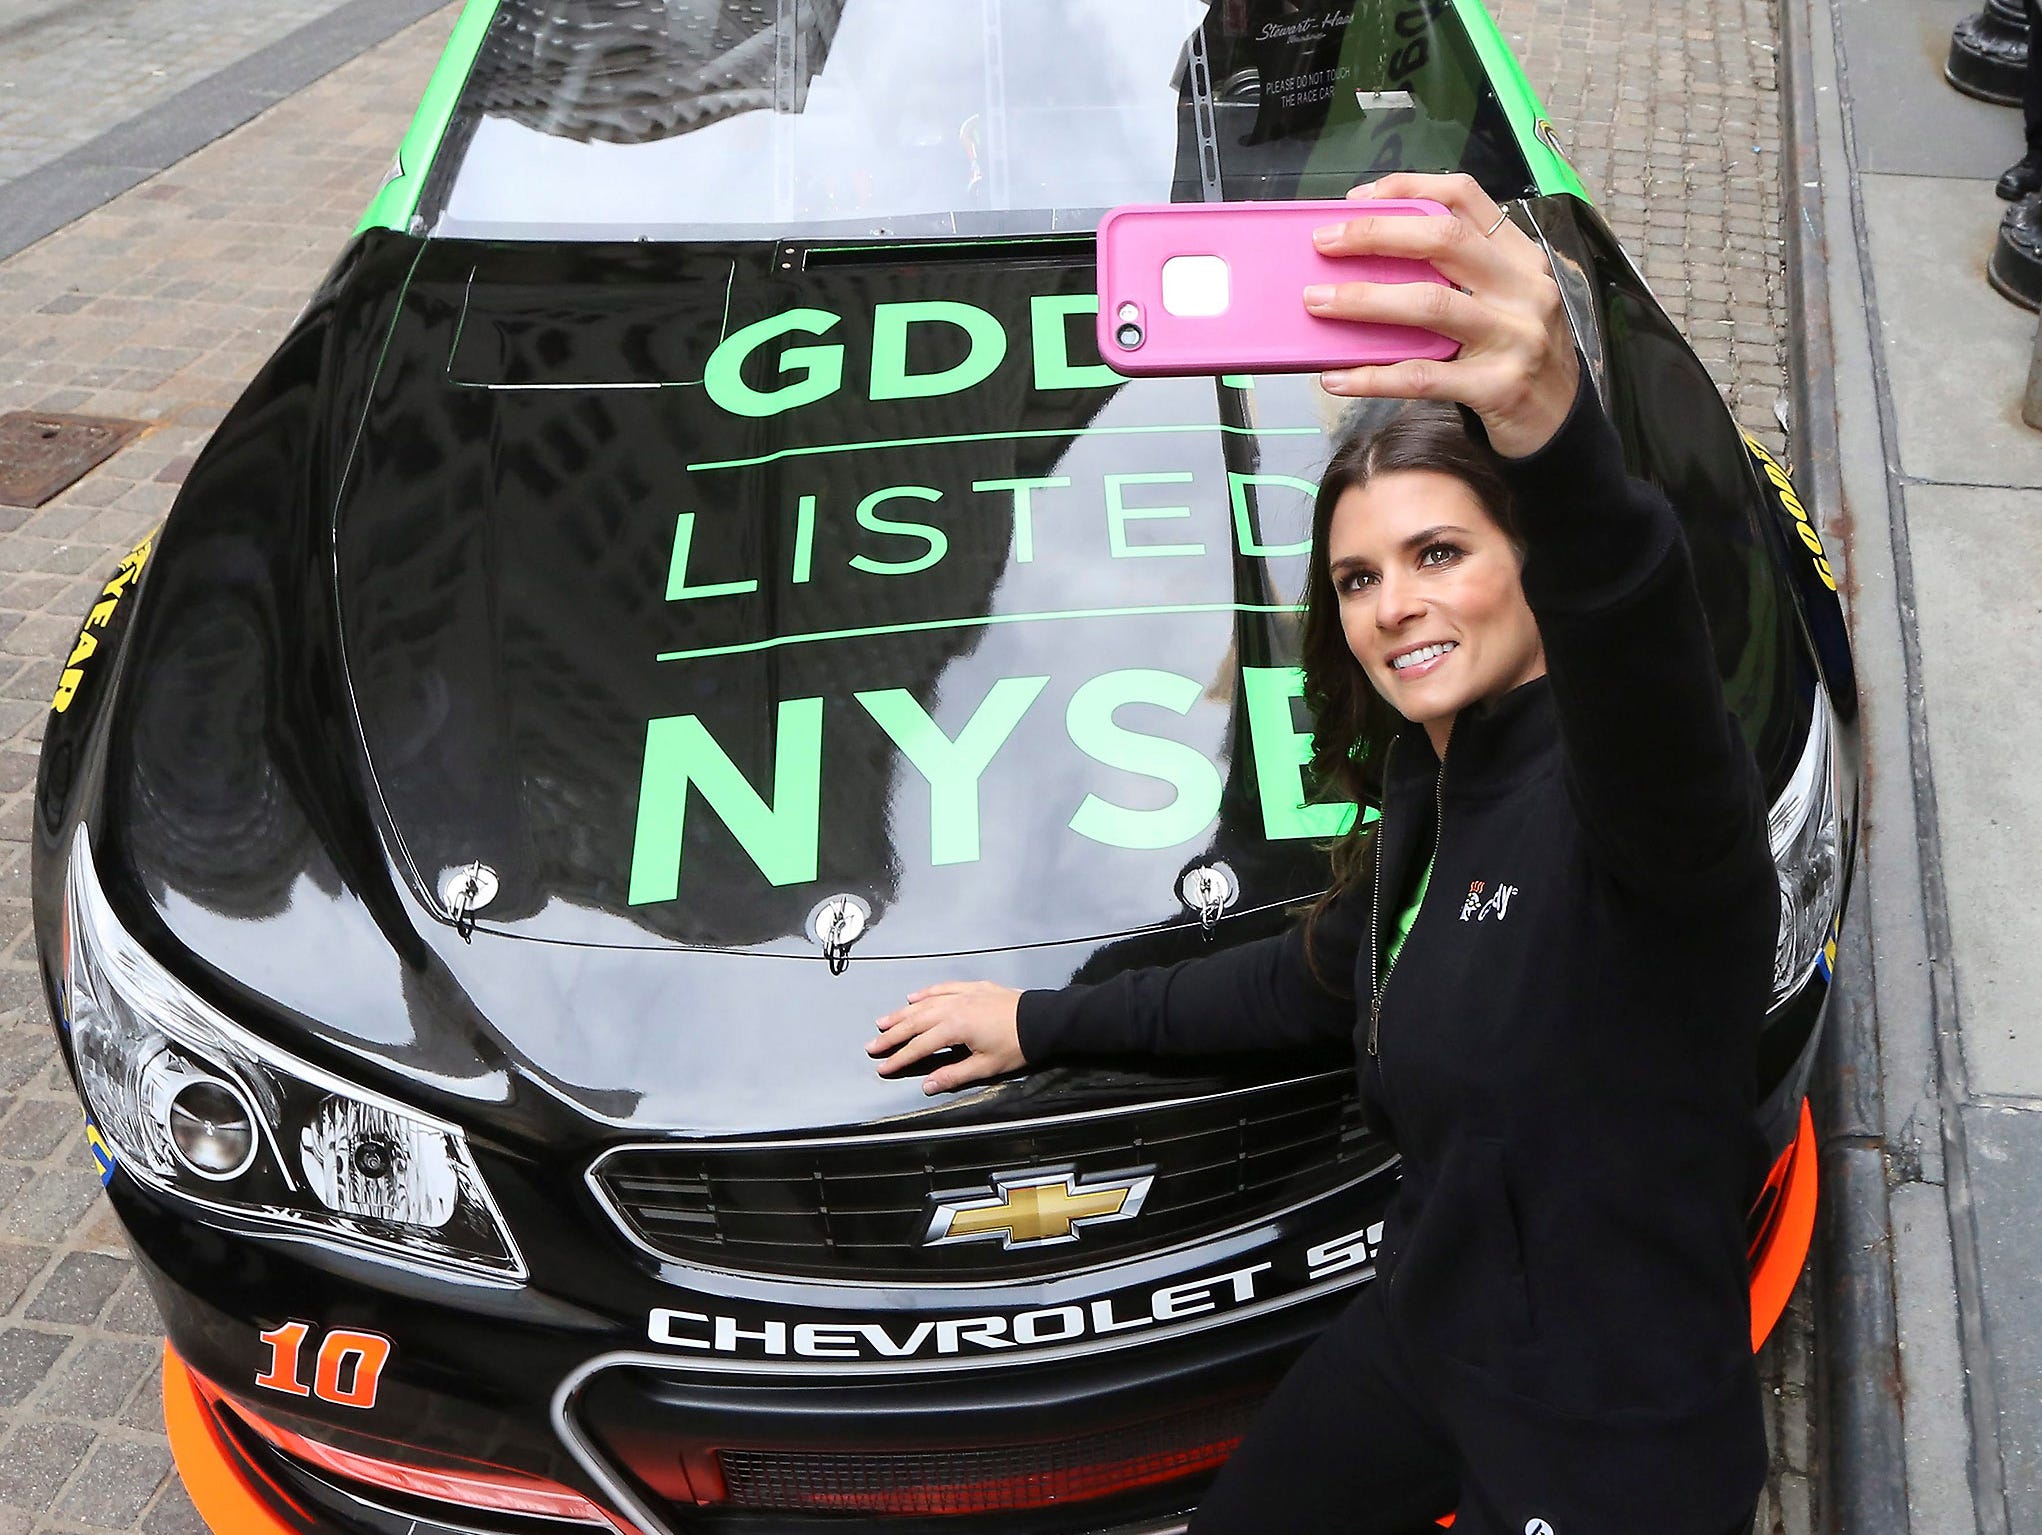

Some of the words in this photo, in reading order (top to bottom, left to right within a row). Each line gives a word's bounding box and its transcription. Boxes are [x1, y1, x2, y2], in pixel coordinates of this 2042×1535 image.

[1266, 78, 1295, 95] PLEASE
[1297, 76, 1307, 88] DO
[1309, 72, 1323, 85] NOT
[1326, 67, 1350, 81] TOUCH
[1281, 96, 1295, 108] THE
[1297, 90, 1317, 104] RACE
[1319, 86, 1335, 99] CAR
[704, 294, 1255, 416] GDD
[665, 472, 1320, 600] LISTED
[628, 666, 1378, 905] NYSE
[648, 1262, 1273, 1357] CHEVROLET
[1306, 1221, 1384, 1280] S
[254, 1321, 391, 1409] 10
